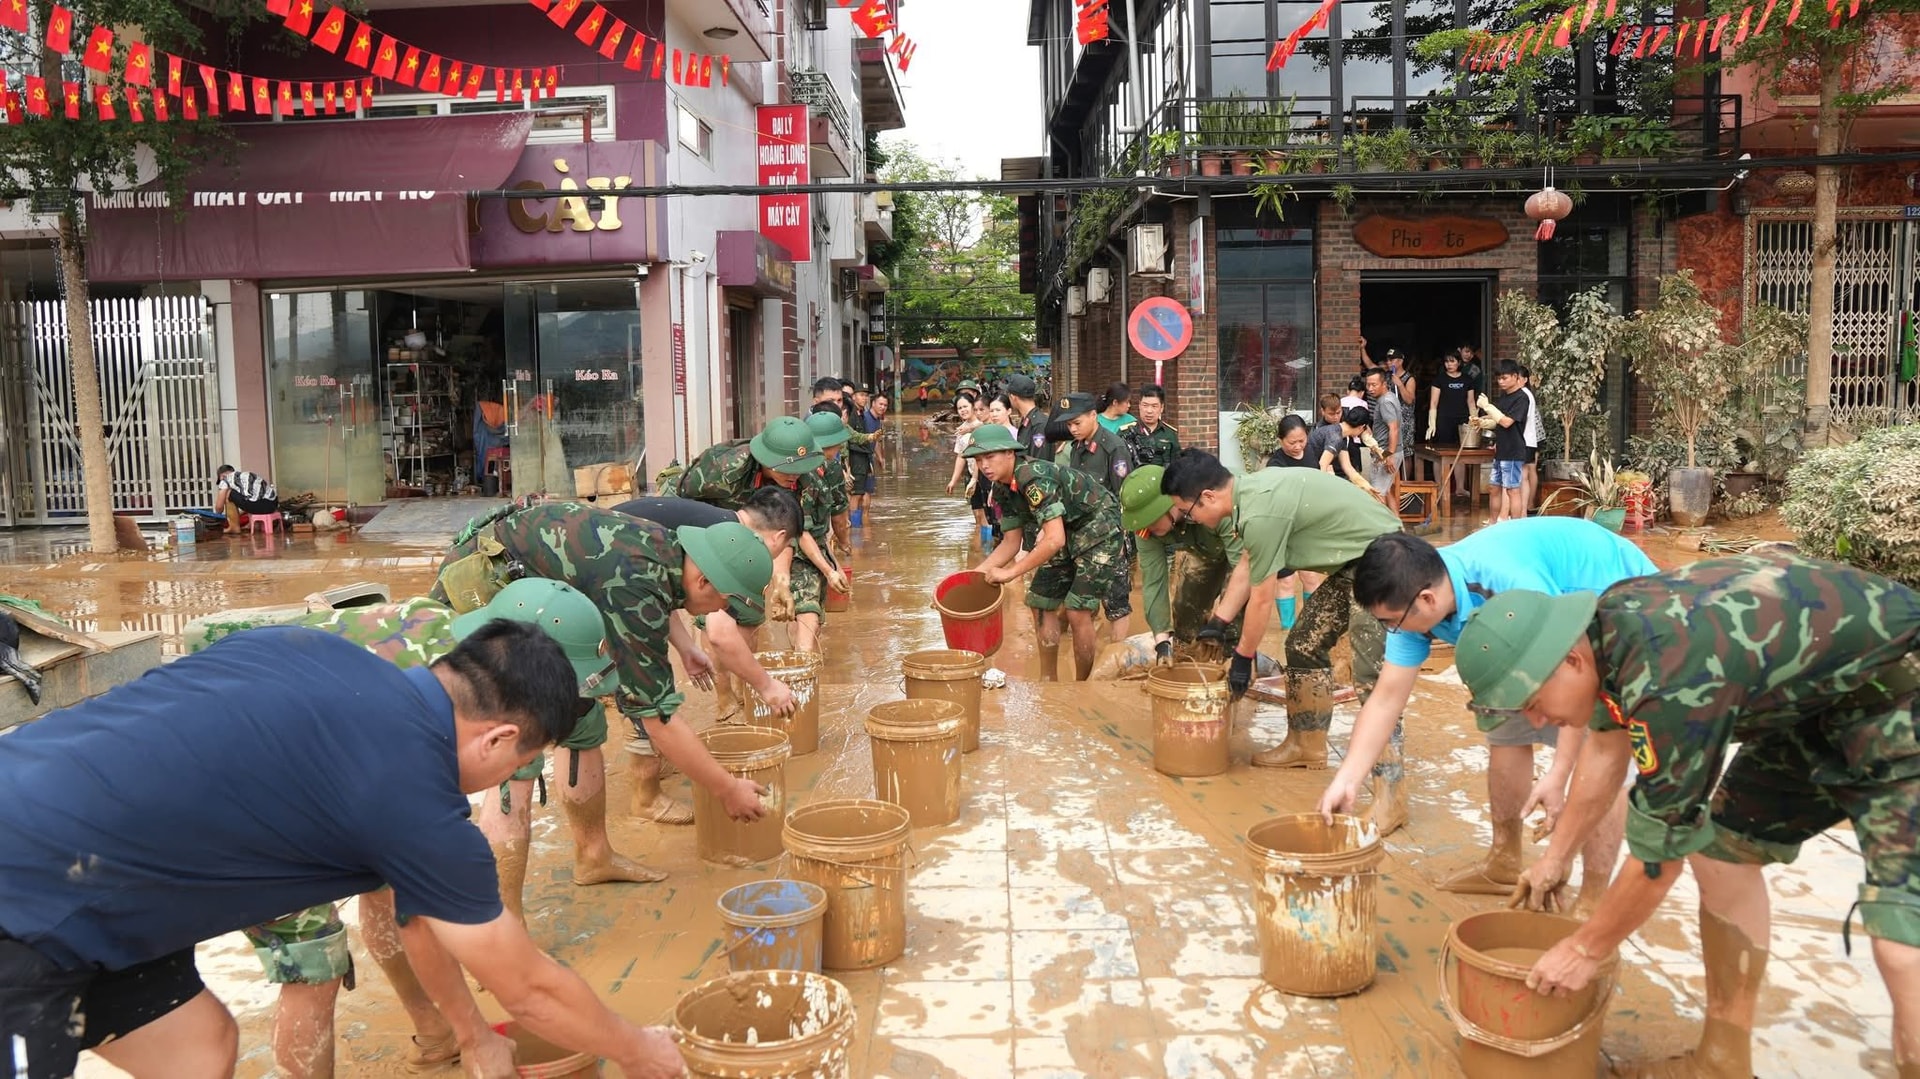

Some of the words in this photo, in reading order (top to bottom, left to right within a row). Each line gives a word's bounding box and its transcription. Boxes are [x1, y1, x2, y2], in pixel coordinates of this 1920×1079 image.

[784, 113, 793, 135] LÝ
[760, 140, 785, 166] HOÀNG
[786, 144, 806, 165] LONG
[768, 202, 784, 227] MÁY
[785, 202, 801, 226] CÀY
[575, 369, 600, 381] Kéo
[601, 369, 619, 381] Ra
